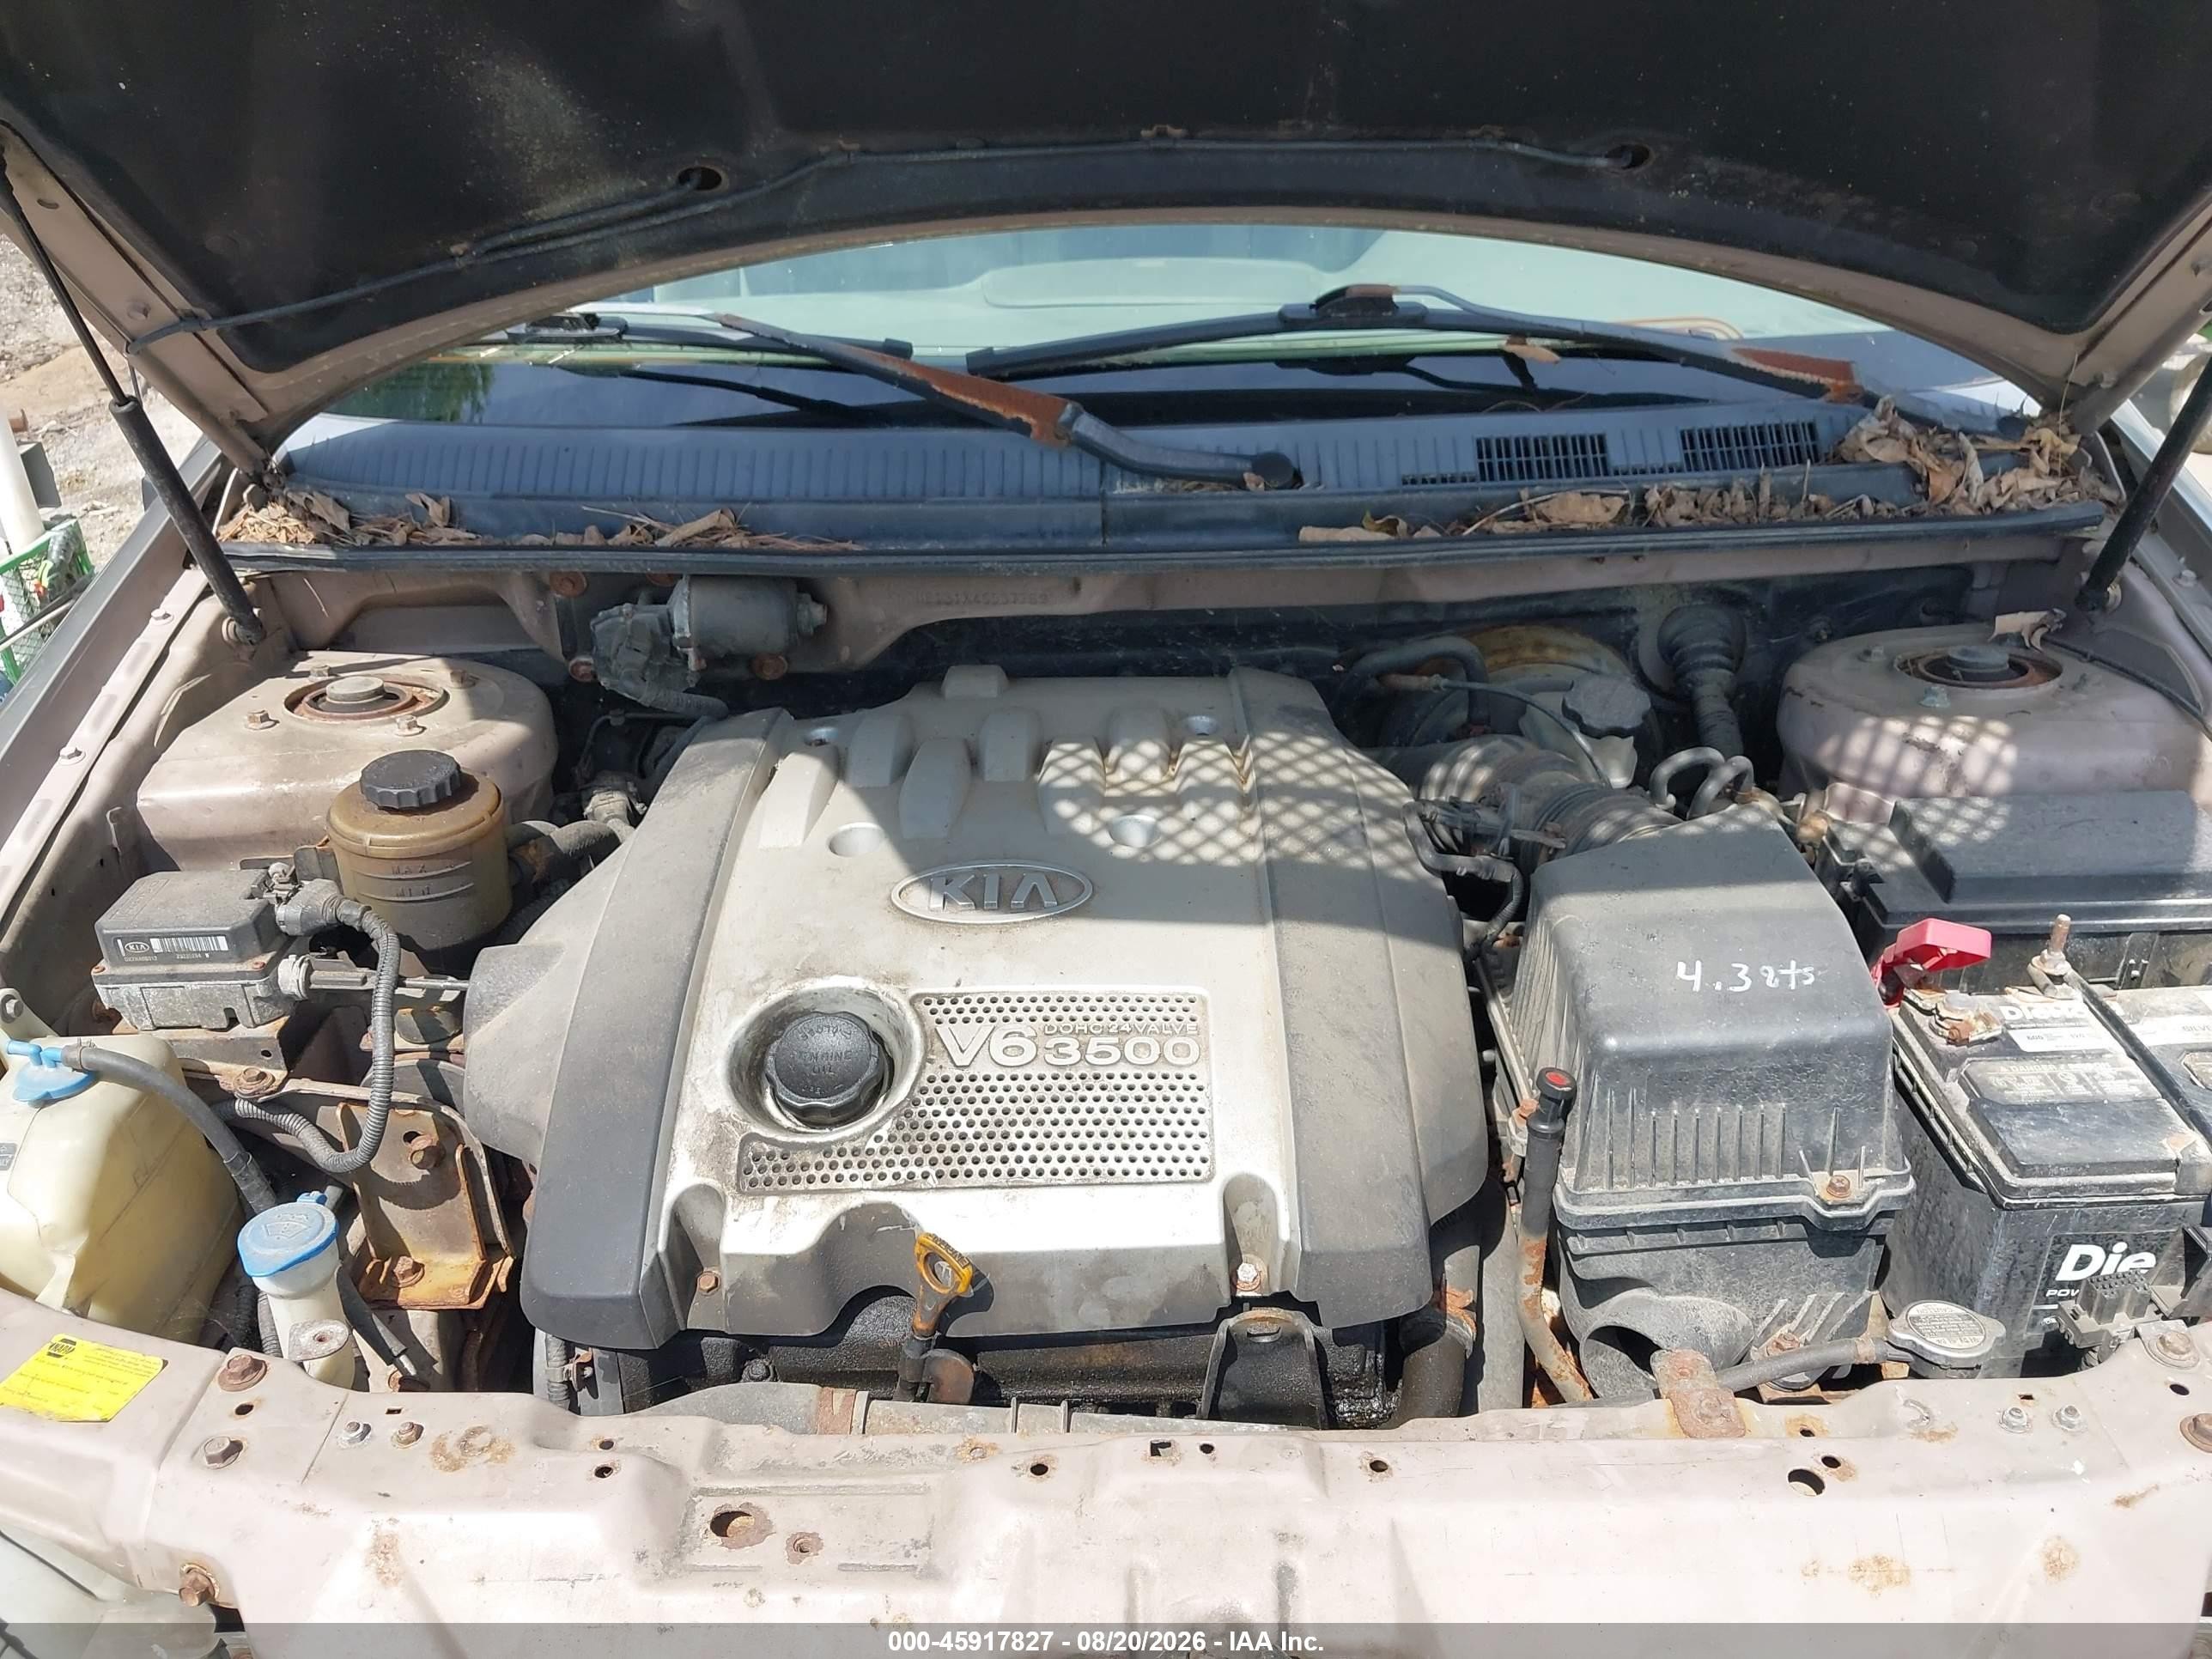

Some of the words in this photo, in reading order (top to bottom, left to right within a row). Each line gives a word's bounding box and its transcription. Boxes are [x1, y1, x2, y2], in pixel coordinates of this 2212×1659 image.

[929, 872, 1059, 911] KIA
[935, 1024, 1038, 1068] V6
[1042, 1036, 1201, 1066] 3500
[1044, 1023, 1103, 1036] DOHC
